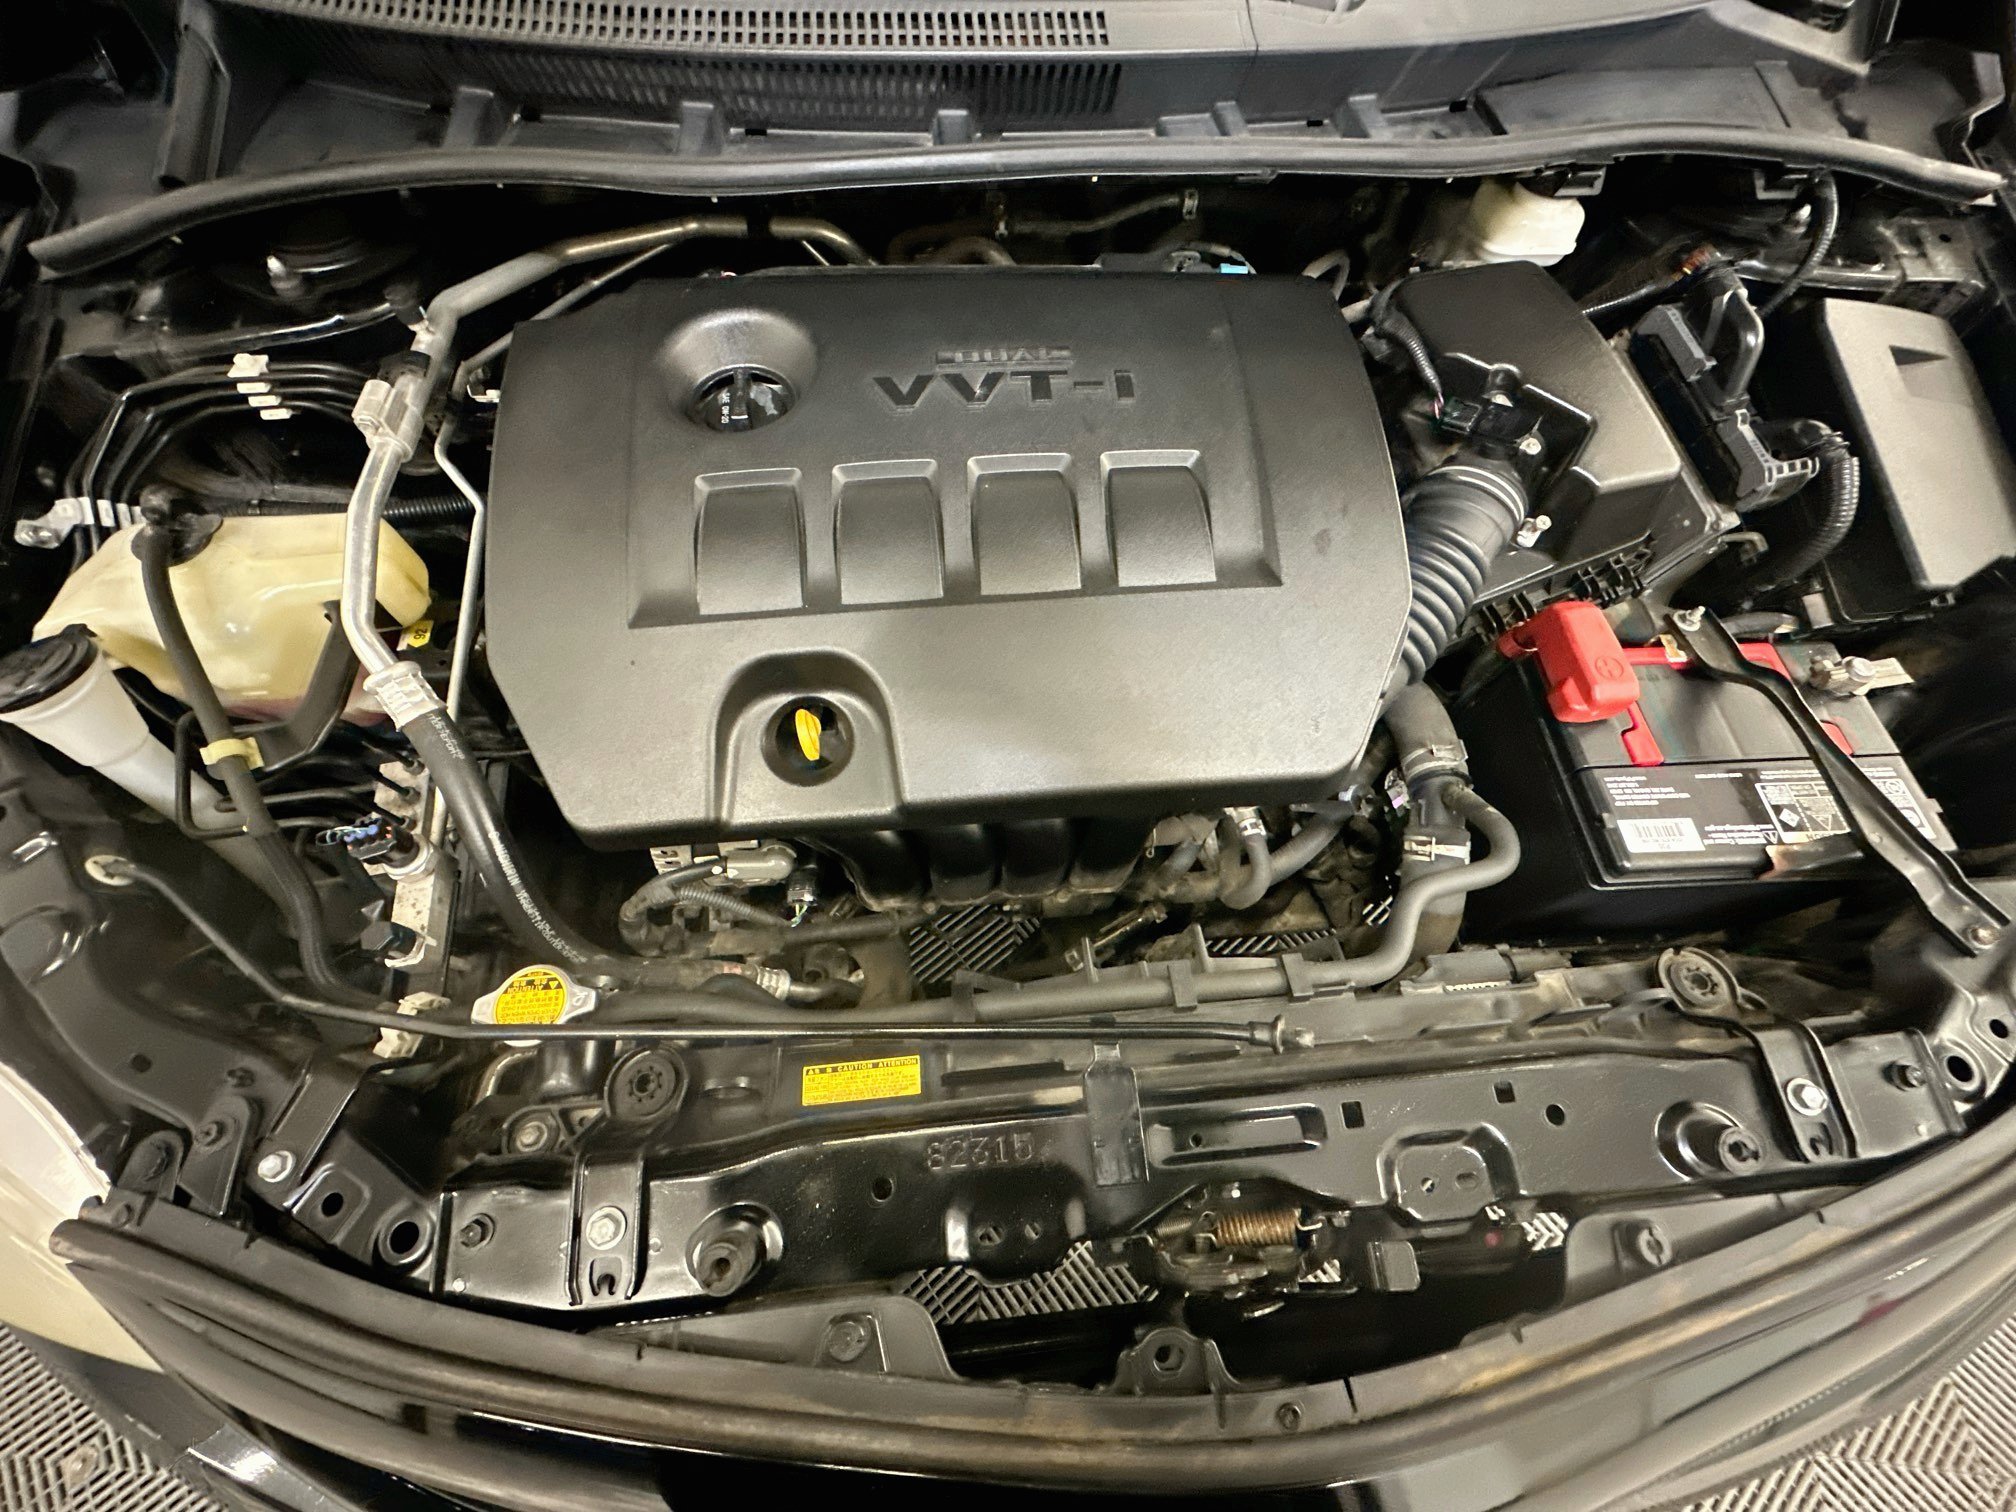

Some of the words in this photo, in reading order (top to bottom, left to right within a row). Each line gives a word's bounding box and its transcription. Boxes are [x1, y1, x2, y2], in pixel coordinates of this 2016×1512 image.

[953, 347, 1057, 363] DUAL
[721, 392, 731, 404] SAE
[720, 405, 730, 424] 0W-20
[492, 842, 522, 888] NICHIRIN
[507, 985, 543, 995] ATTENTION
[837, 1063, 873, 1072] CAUTION
[878, 1058, 917, 1068] ATTENTION
